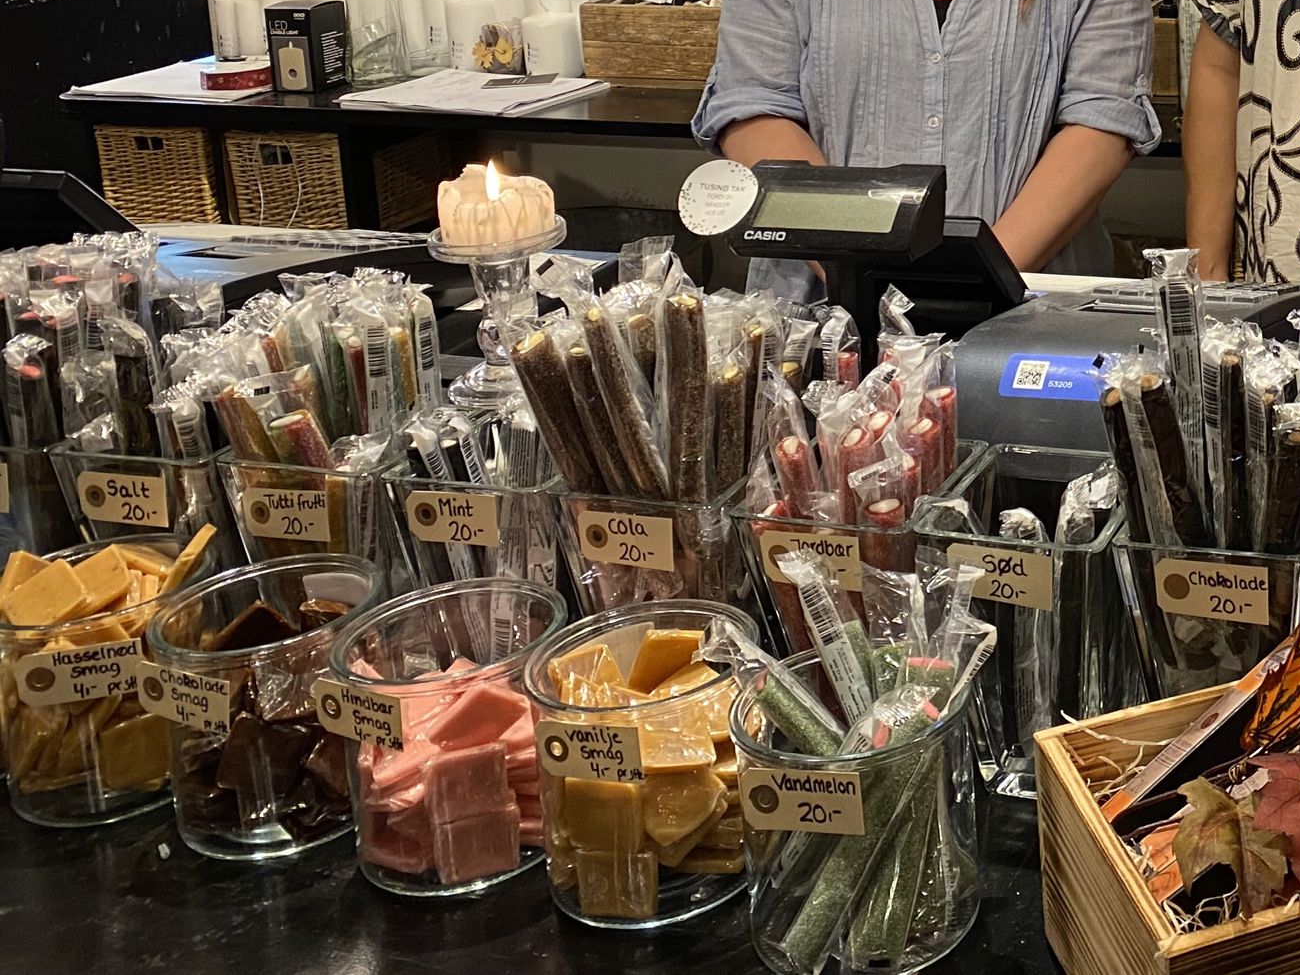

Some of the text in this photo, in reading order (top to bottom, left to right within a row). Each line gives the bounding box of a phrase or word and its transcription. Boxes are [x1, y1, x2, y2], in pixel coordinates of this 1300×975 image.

[269, 20, 287, 31] LED
[700, 182, 729, 192] TUSIND
[743, 230, 787, 241] CASIO
[106, 479, 150, 498] Salt
[263, 492, 294, 510] Tutti
[438, 497, 474, 517] Mint
[982, 554, 1028, 577] Sød
[1188, 571, 1268, 591] Chokolade
[160, 669, 228, 696] Chokolade
[770, 773, 856, 796] Vandmelon
